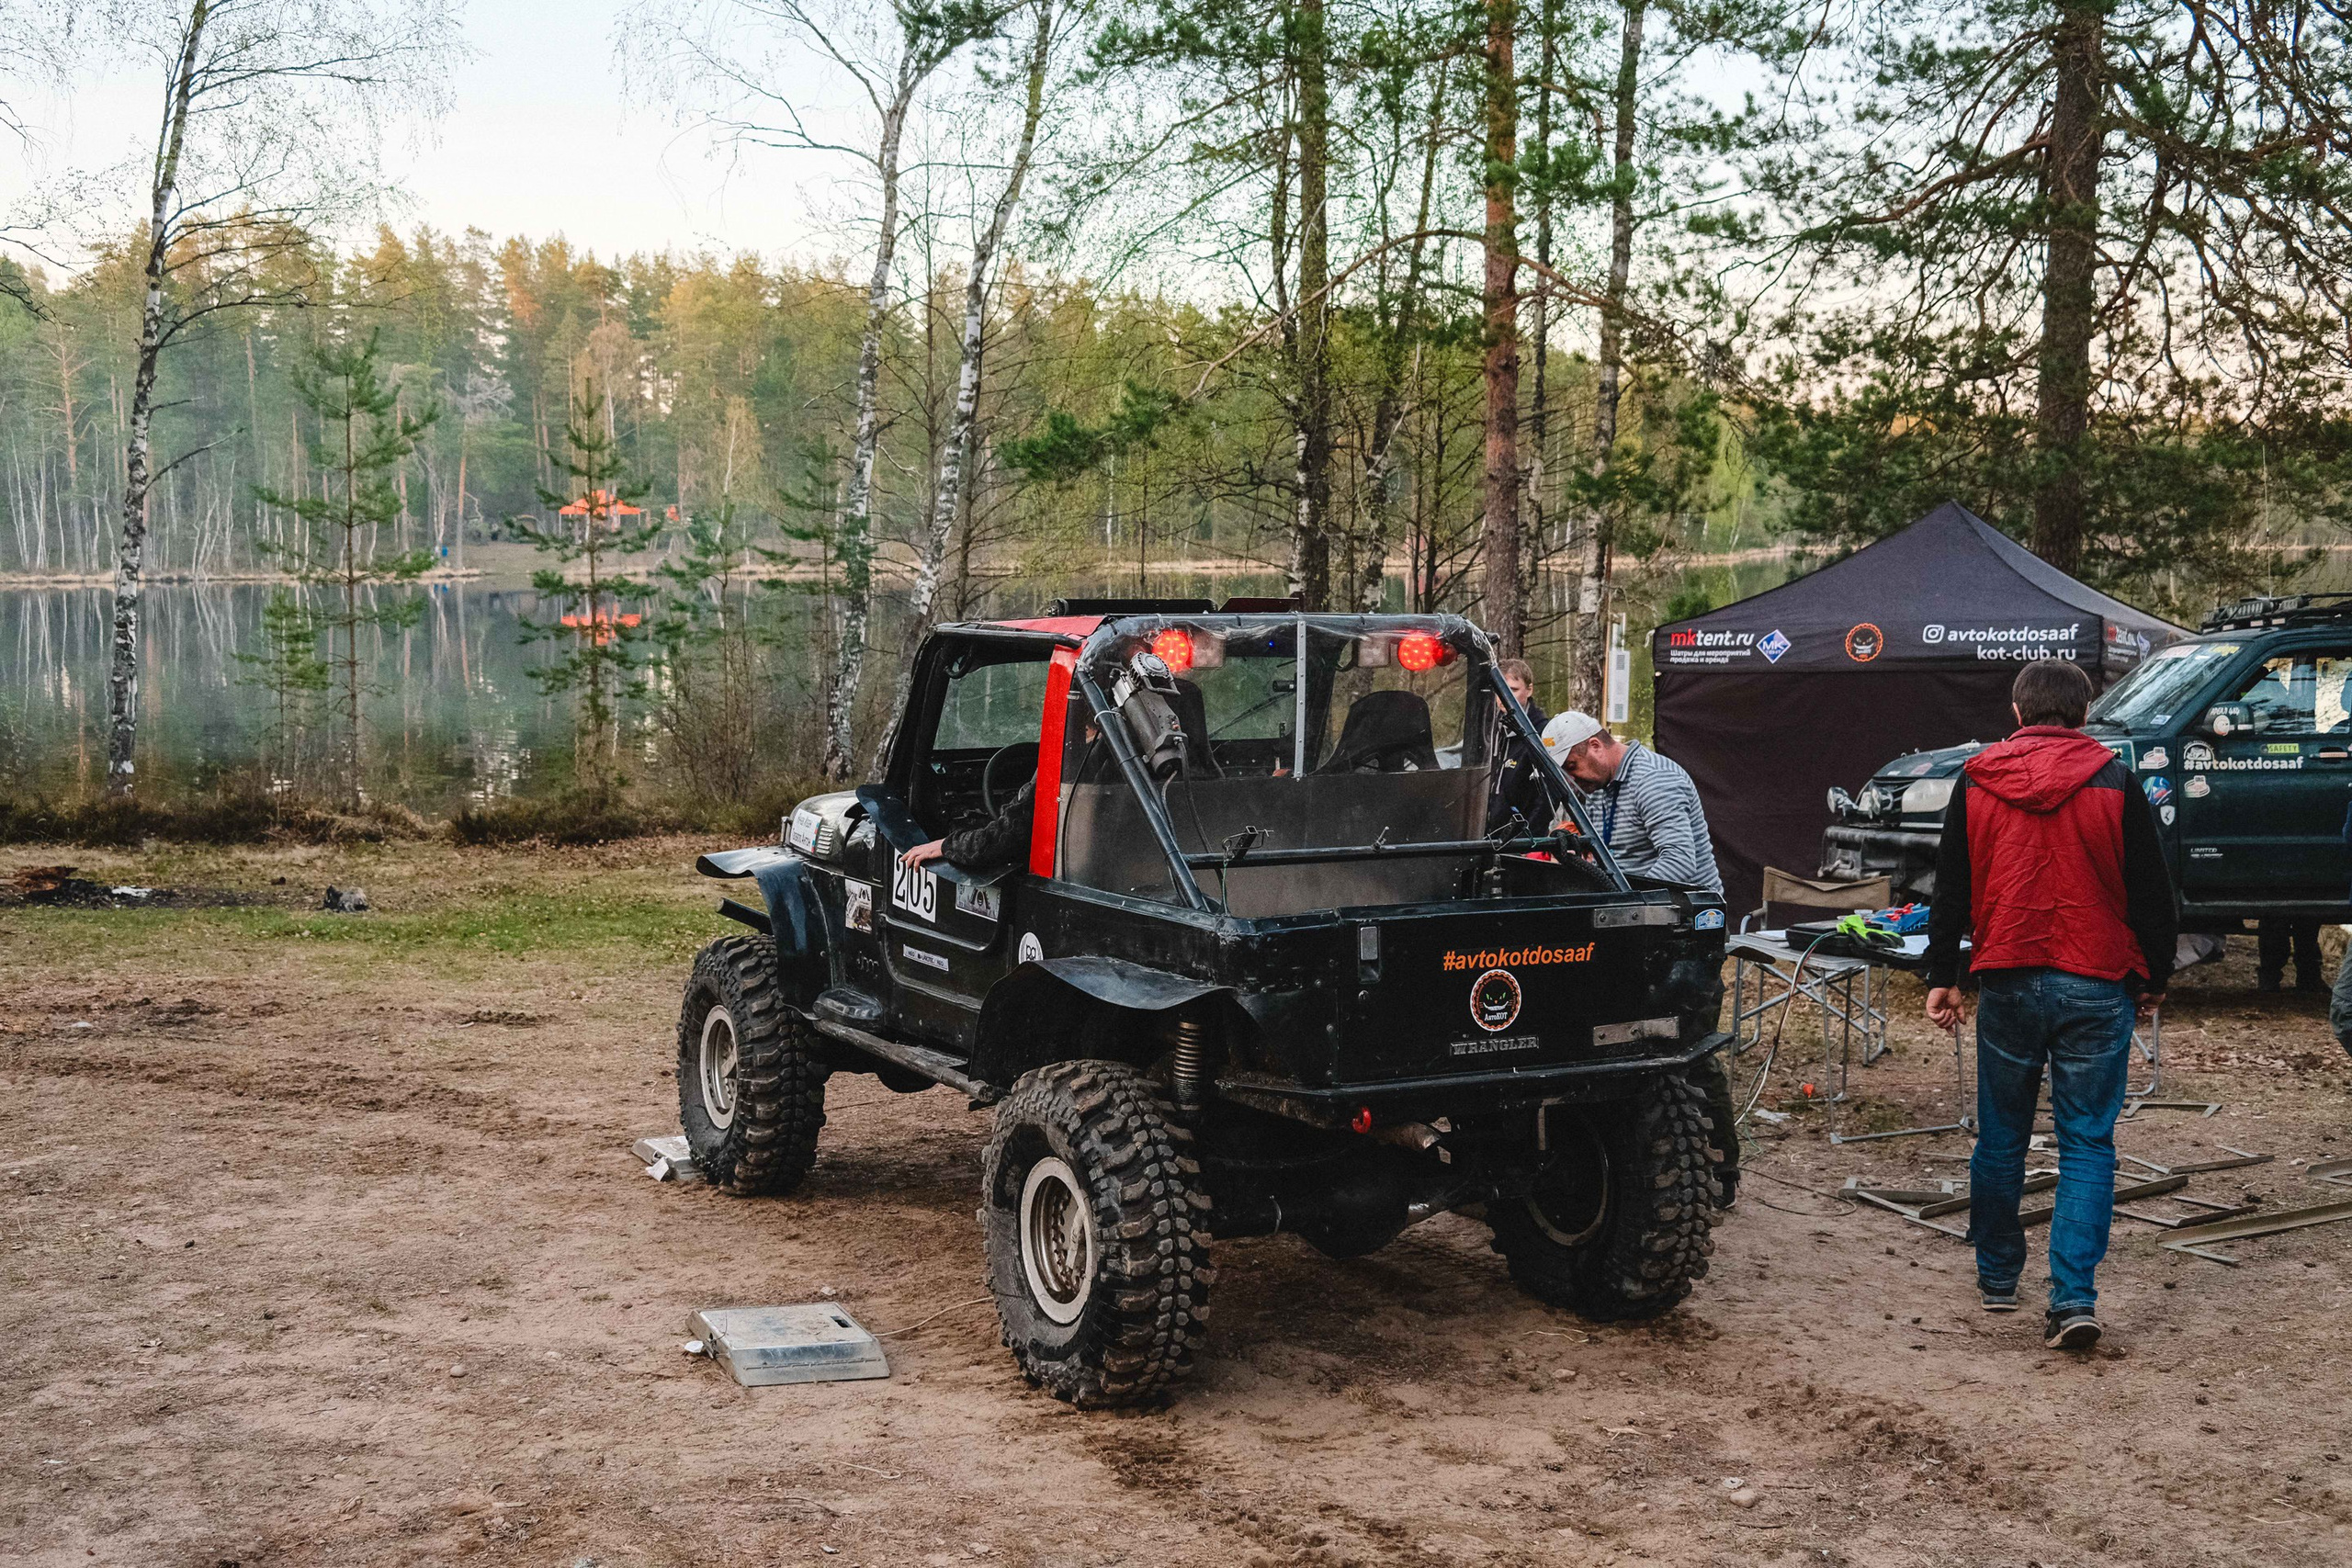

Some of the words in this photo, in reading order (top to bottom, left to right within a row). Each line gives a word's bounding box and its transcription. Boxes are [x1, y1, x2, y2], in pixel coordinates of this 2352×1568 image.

[1670, 628, 1755, 647] mktent.ru
[1947, 624, 2079, 642] avtokotdosaaf
[1977, 645, 2076, 660] kot-club.ru
[2267, 744, 2298, 753] SAFETY
[2184, 756, 2304, 771] #avtokotdosaaf
[895, 854, 935, 914] 205
[1443, 942, 1595, 971] #avtokotdosaaf
[1453, 1036, 1538, 1055] WRANGLER
